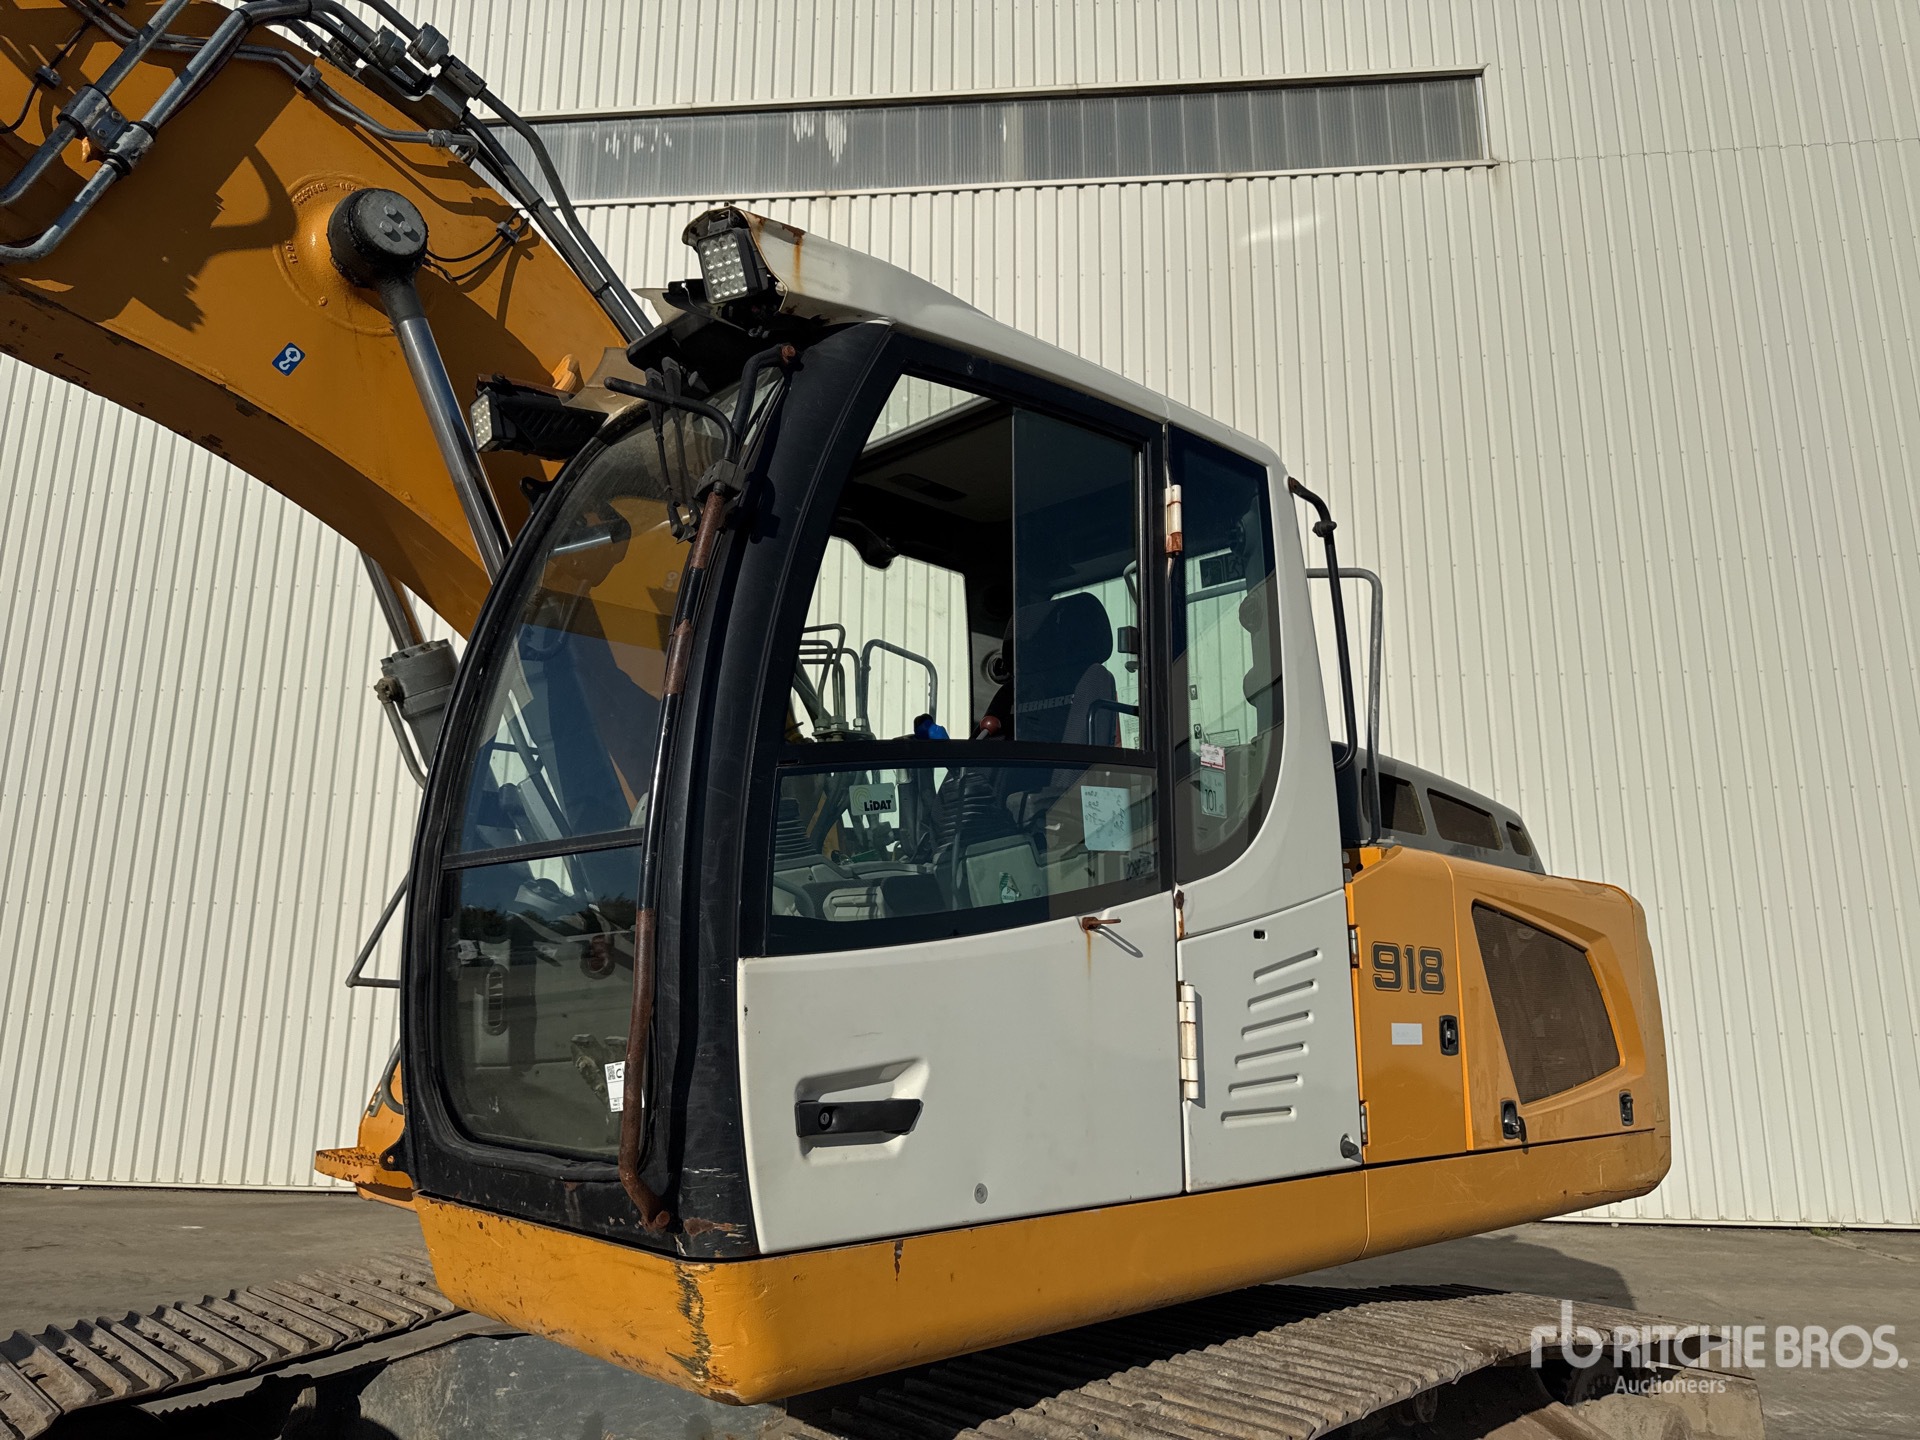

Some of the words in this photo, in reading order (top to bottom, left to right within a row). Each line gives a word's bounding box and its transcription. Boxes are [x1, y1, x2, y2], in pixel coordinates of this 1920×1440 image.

[864, 800, 891, 811] LiDAT
[1205, 788, 1217, 812] 101
[1371, 941, 1445, 995] 918
